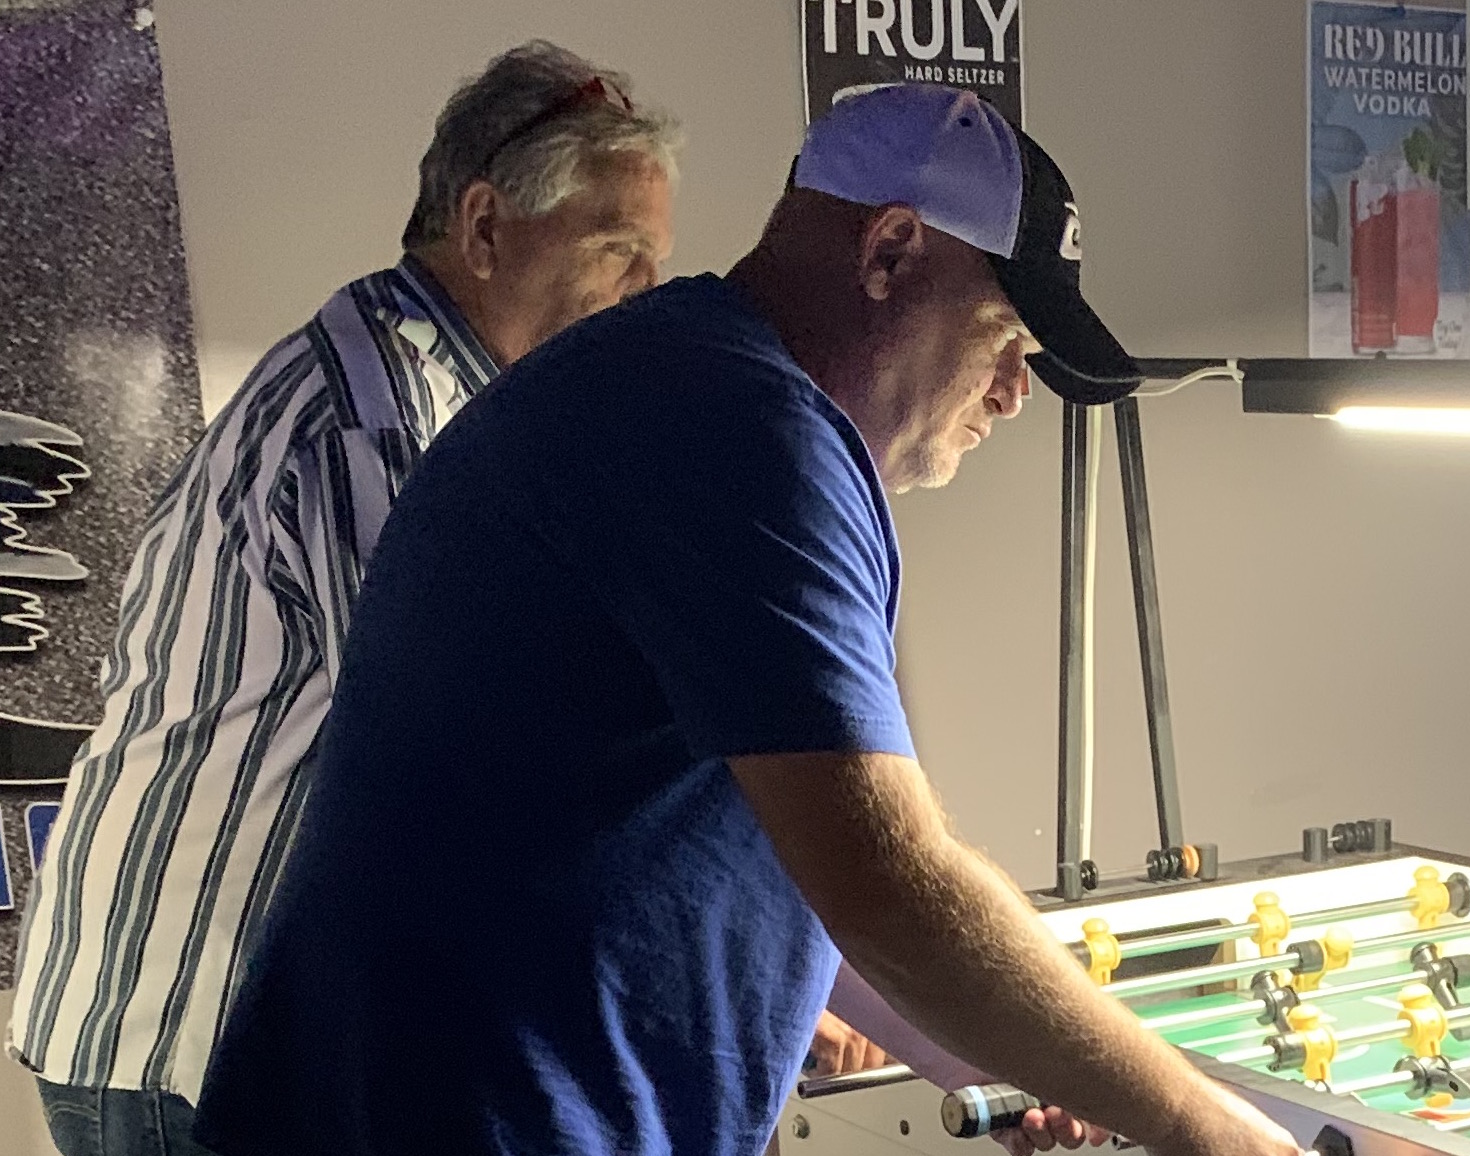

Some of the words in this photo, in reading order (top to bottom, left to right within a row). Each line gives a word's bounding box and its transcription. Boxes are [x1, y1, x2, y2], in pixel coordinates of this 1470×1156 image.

[810, 0, 1019, 62] TRULY
[1324, 24, 1385, 62] RED
[1393, 29, 1466, 68] BULL
[904, 65, 943, 82] HARD
[947, 66, 1005, 85] SELTZER
[1323, 65, 1466, 96] WATERMELON
[1353, 93, 1432, 117] VODKA
